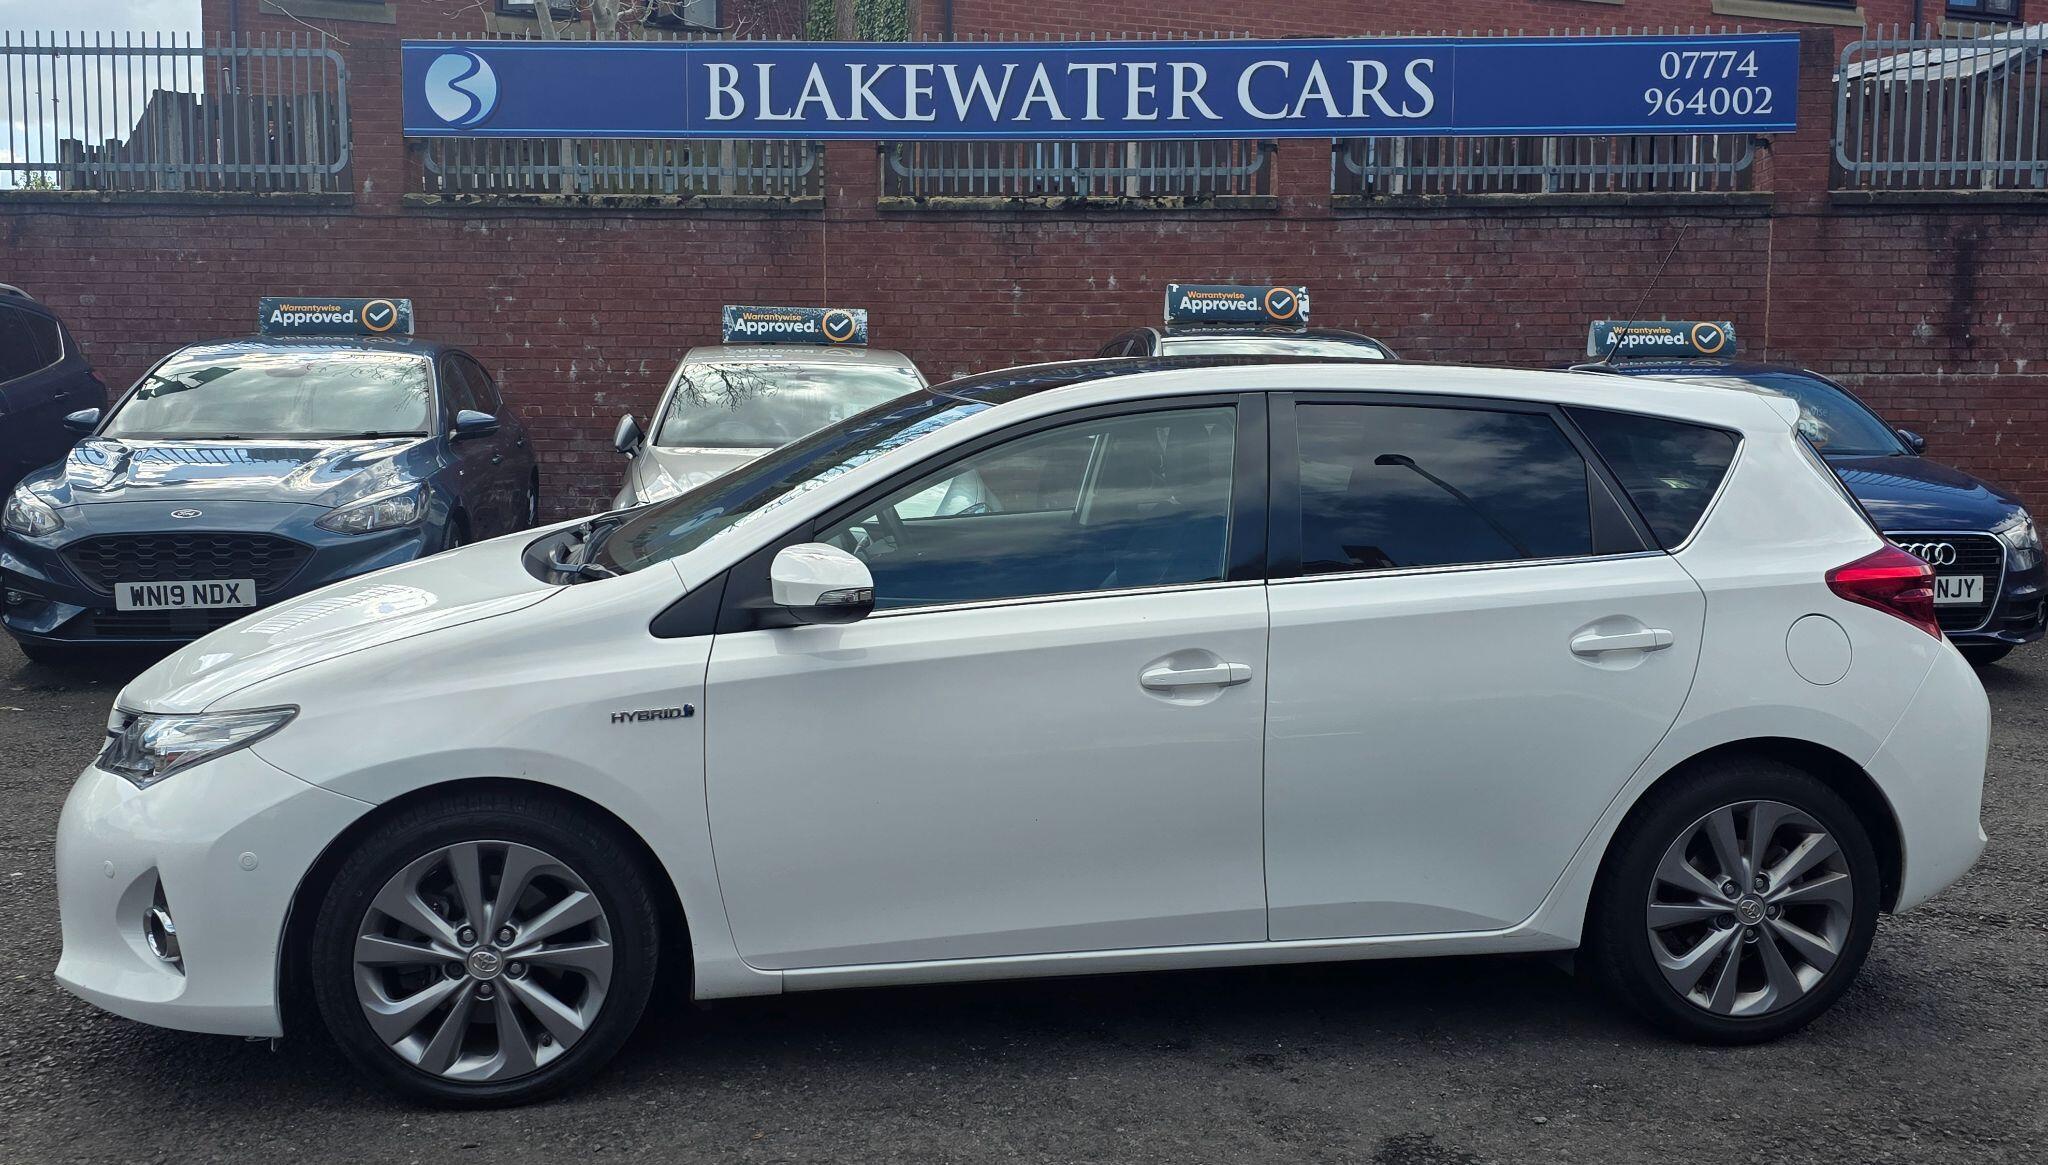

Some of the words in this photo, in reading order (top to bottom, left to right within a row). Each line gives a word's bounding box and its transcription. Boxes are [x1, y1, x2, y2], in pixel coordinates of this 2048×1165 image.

[1659, 50, 1759, 79] 07774
[703, 60, 1223, 122] BLAKEWATER
[1236, 58, 1435, 119] CARS
[1644, 86, 1773, 116] 964002
[1187, 290, 1245, 300] Warrantywise
[279, 303, 341, 312] Warrantywise
[1180, 296, 1262, 314] Approved.
[270, 309, 358, 326] Approved.
[743, 312, 802, 321] Warrantywise
[735, 318, 819, 335] Approved.
[130, 585, 185, 607] WN19
[192, 582, 241, 605] NDX
[1937, 578, 1975, 599] NJY
[611, 708, 682, 724] HYBRID
